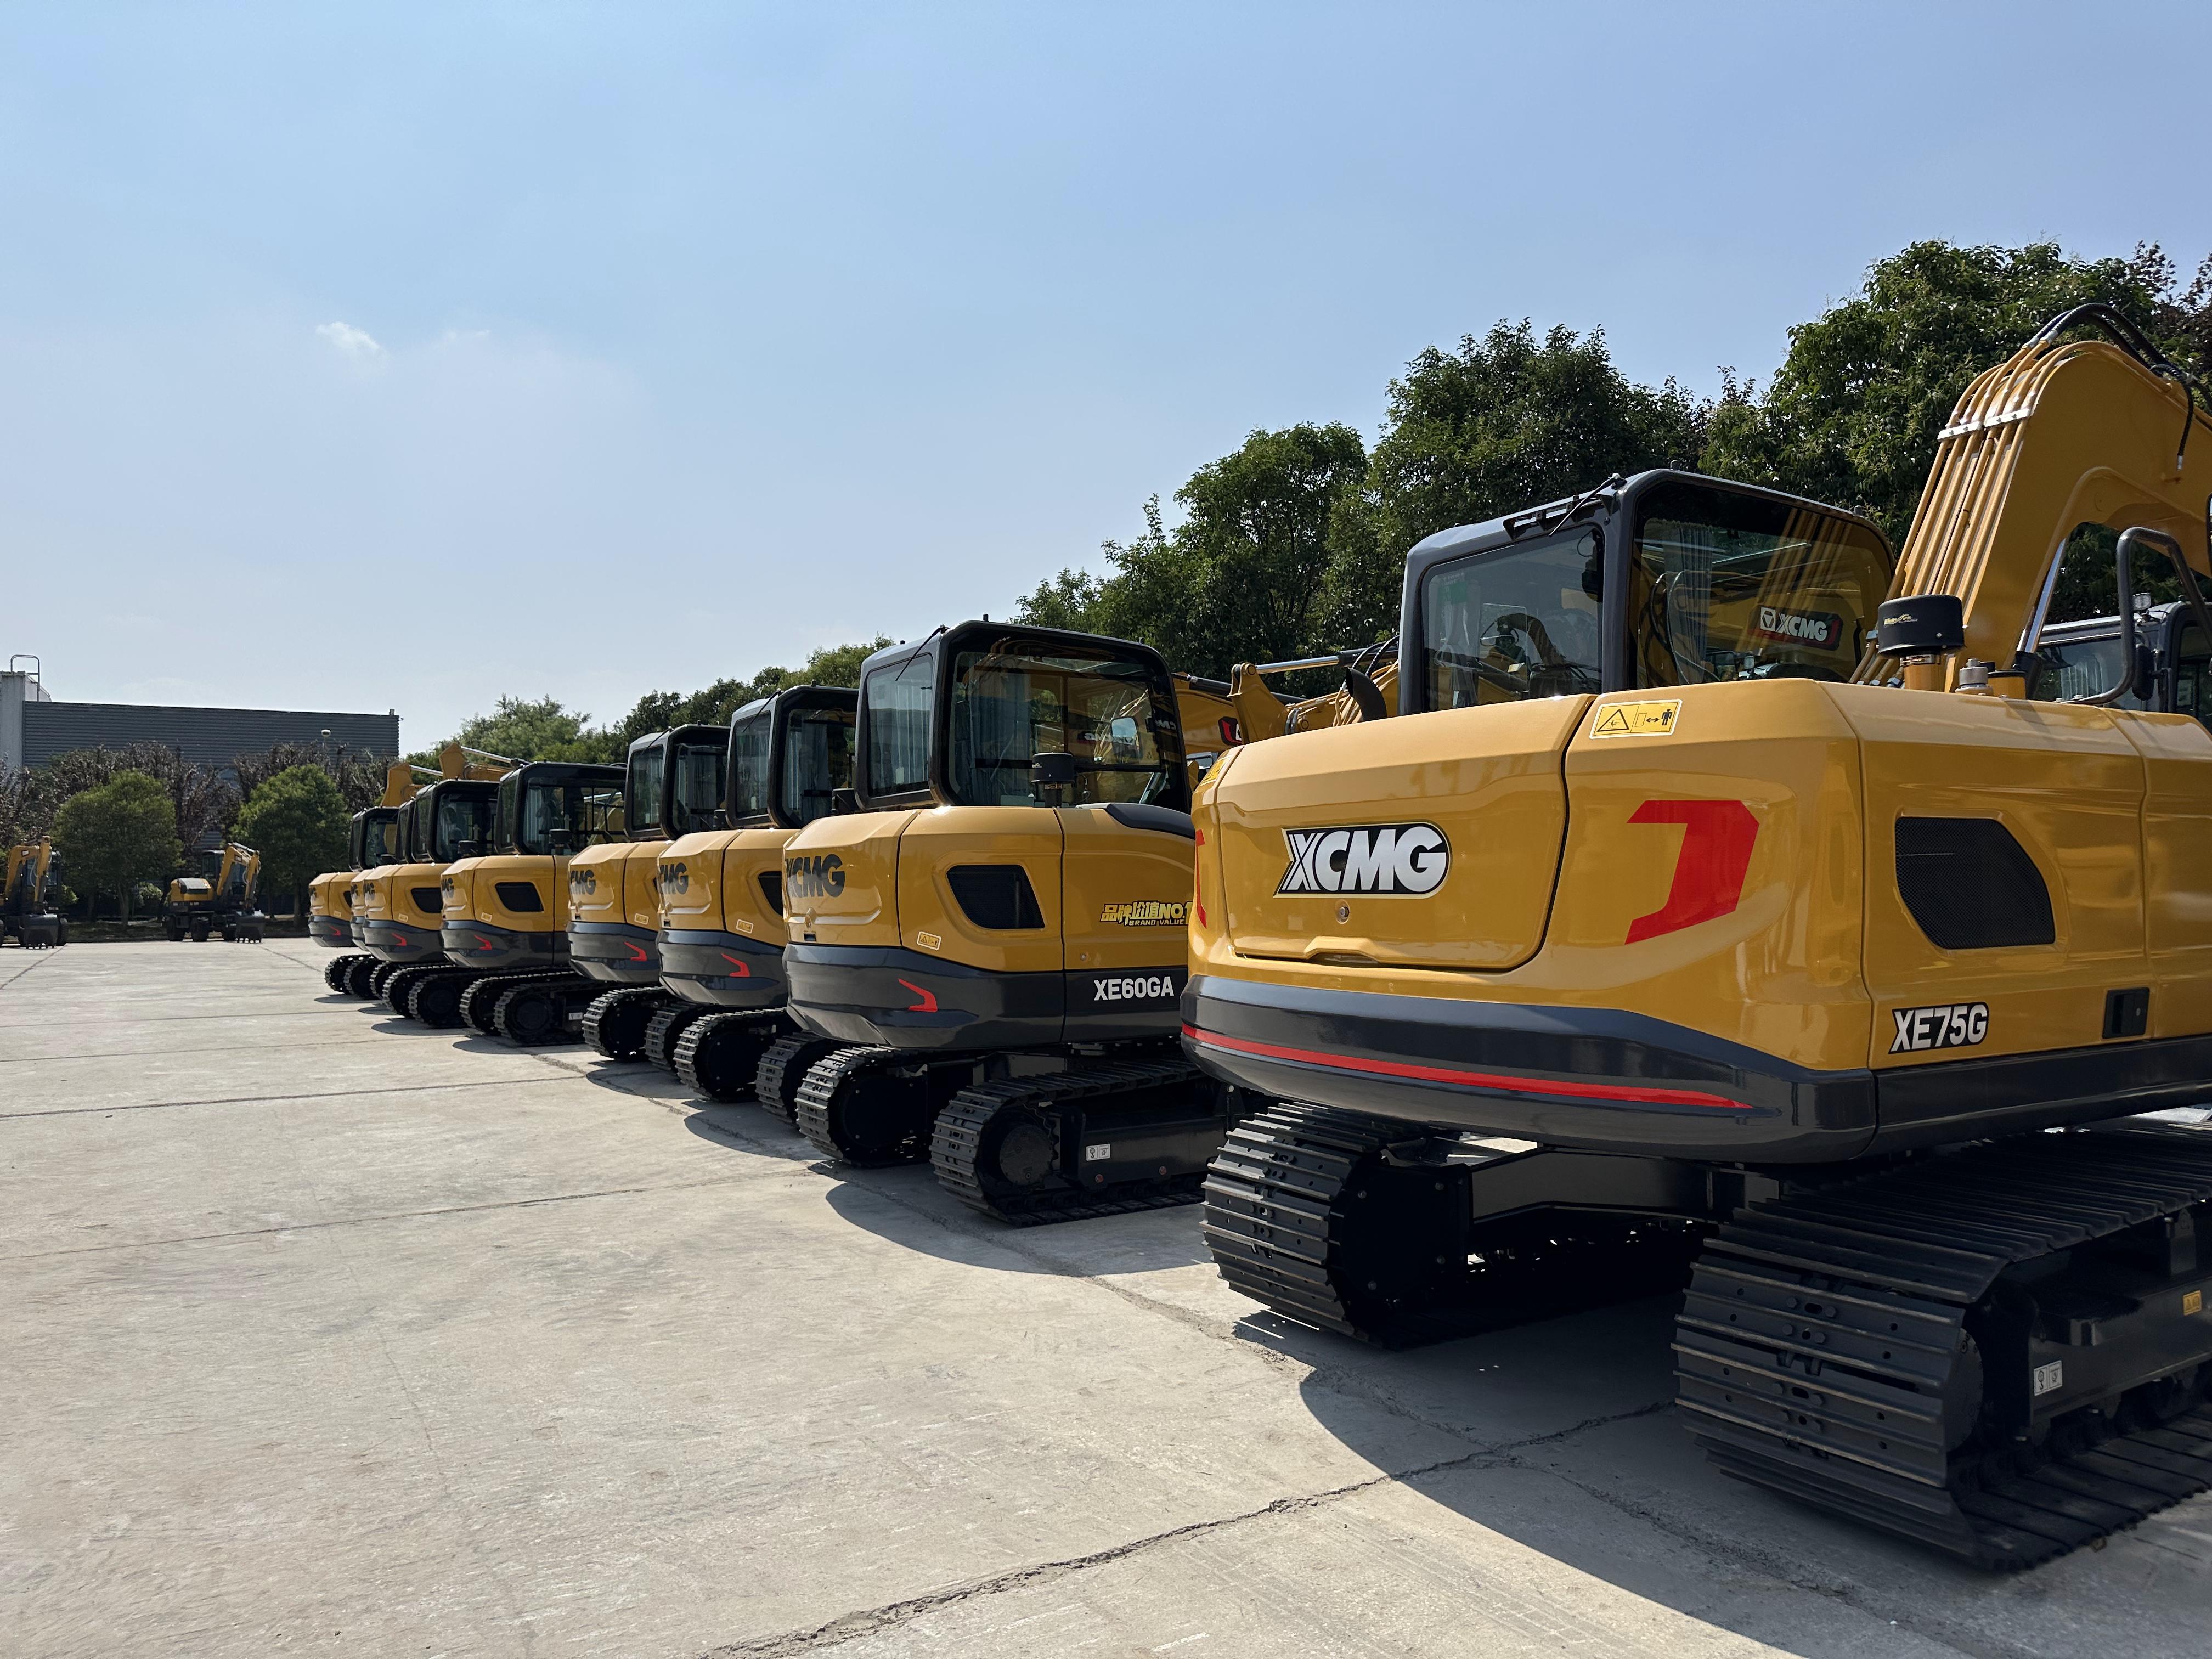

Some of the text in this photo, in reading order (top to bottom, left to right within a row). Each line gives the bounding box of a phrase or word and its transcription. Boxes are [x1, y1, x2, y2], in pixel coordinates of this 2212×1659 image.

[1775, 613, 1827, 642] XCMG
[1282, 826, 1447, 892] XCMG
[1093, 975, 1175, 1001] XE60GA
[1890, 1003, 1988, 1052] XE75G
